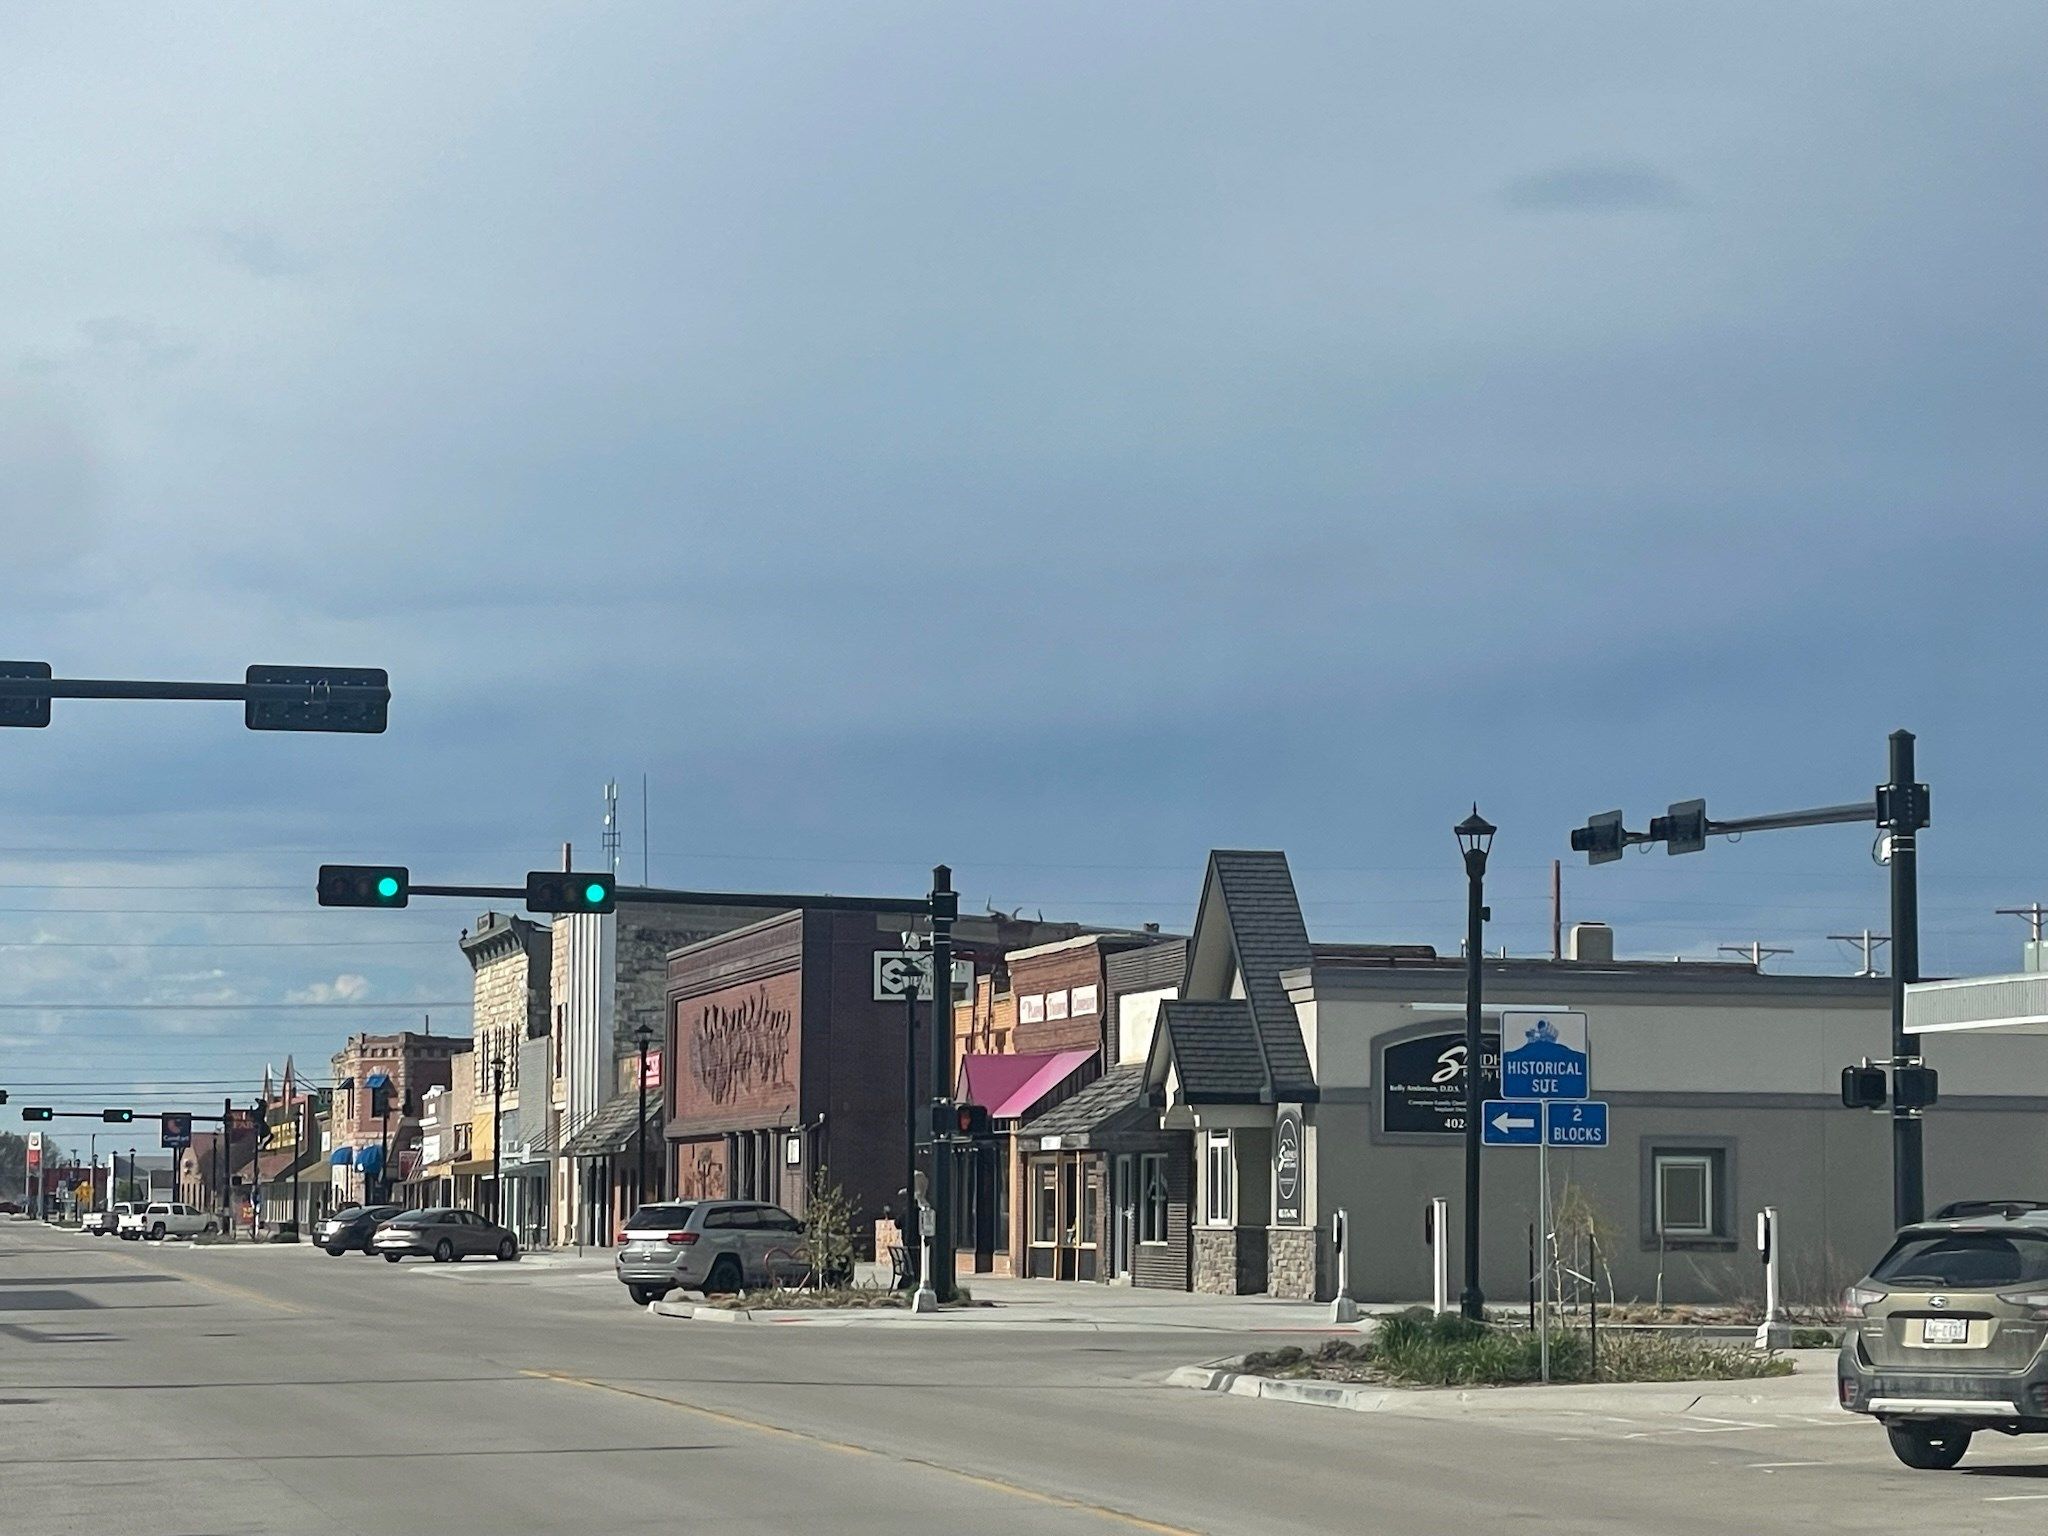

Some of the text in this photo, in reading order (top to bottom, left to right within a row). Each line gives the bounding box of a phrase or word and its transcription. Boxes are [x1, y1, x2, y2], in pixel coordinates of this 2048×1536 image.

[1507, 1061, 1582, 1075] HISTORICAL
[1573, 1108, 1582, 1121] 2
[1554, 1127, 1601, 1141] BLOCKS
